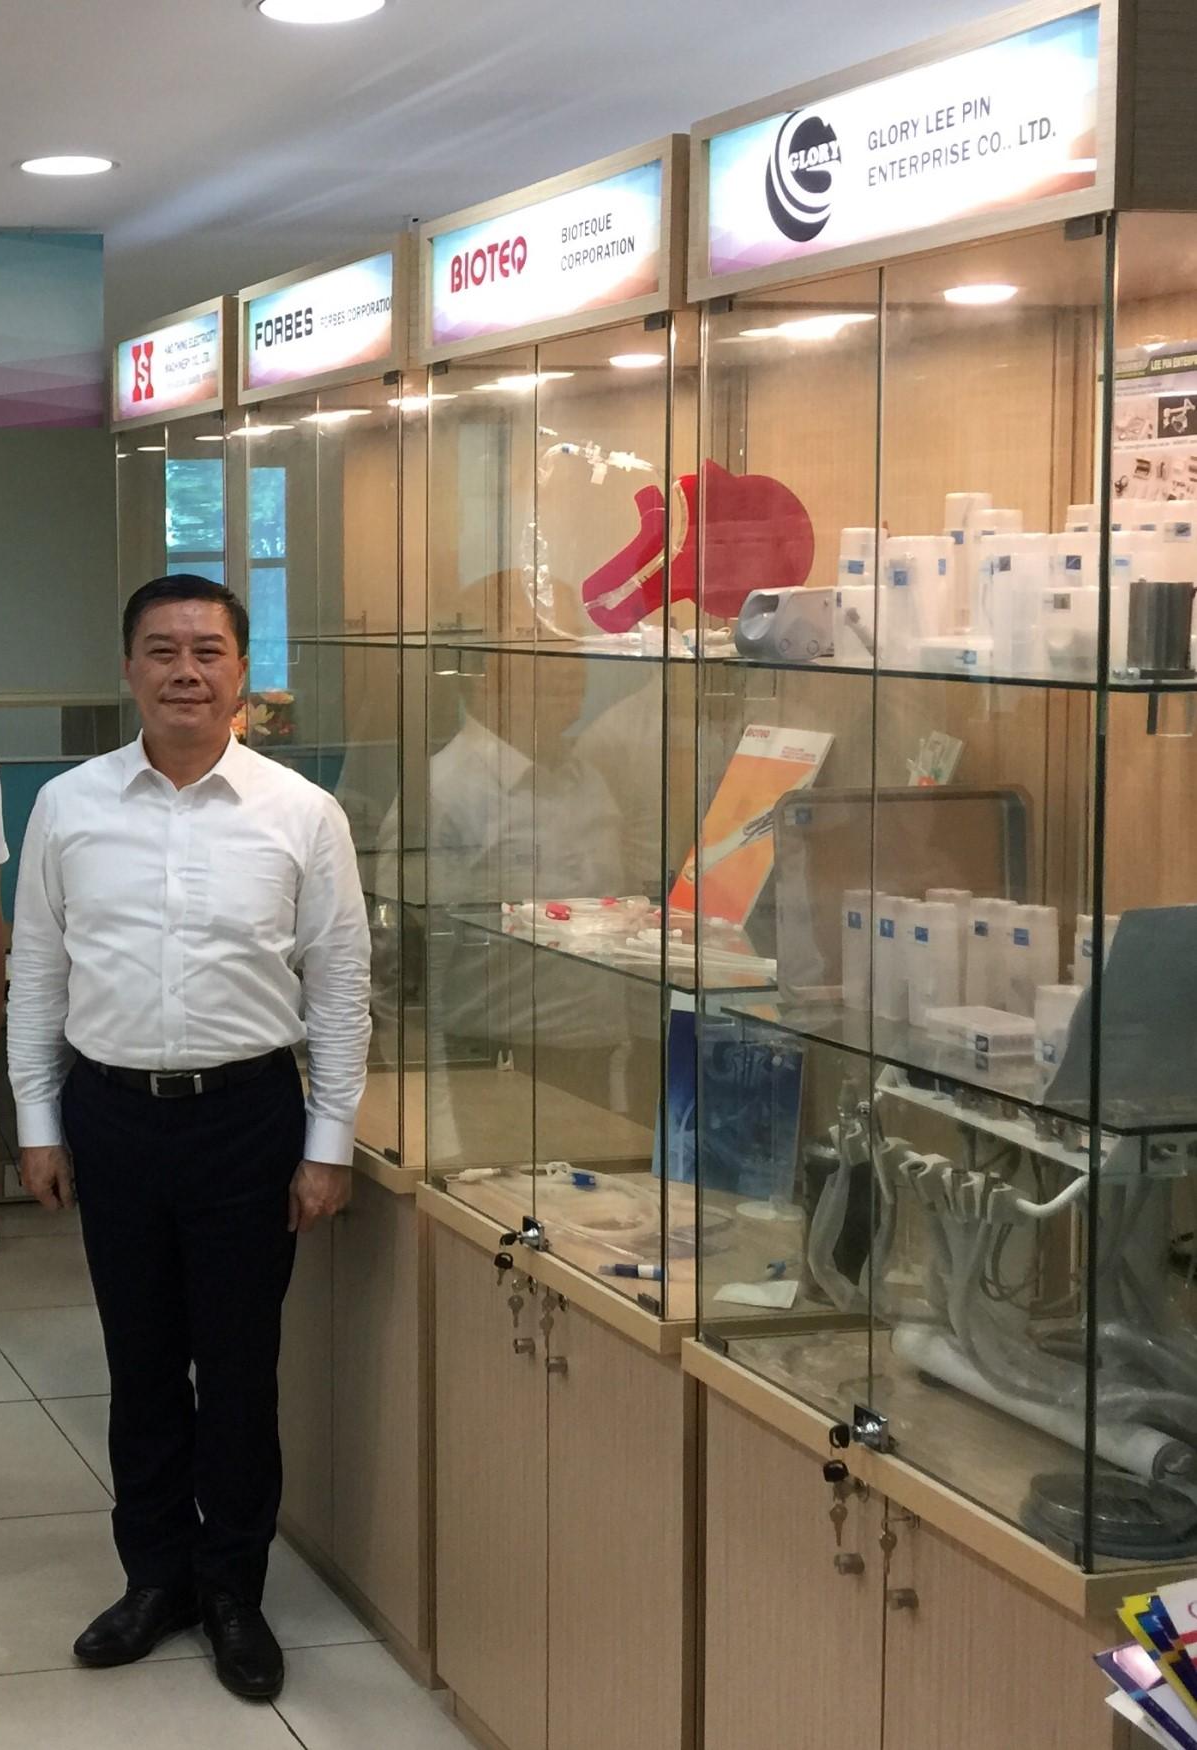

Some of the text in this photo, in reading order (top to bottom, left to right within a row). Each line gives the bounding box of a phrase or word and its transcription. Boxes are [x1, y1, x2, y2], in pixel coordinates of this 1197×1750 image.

[868, 96, 991, 151] GLORY LEE PIN
[788, 140, 840, 172] GLORY
[868, 140, 971, 187] ENTERPRISE
[1019, 117, 1056, 145] LTD.
[561, 213, 613, 243] BIOTEQUE
[450, 235, 528, 293] BIOTEQ
[560, 235, 635, 272] CORPORATION
[255, 307, 313, 351] FORBES
